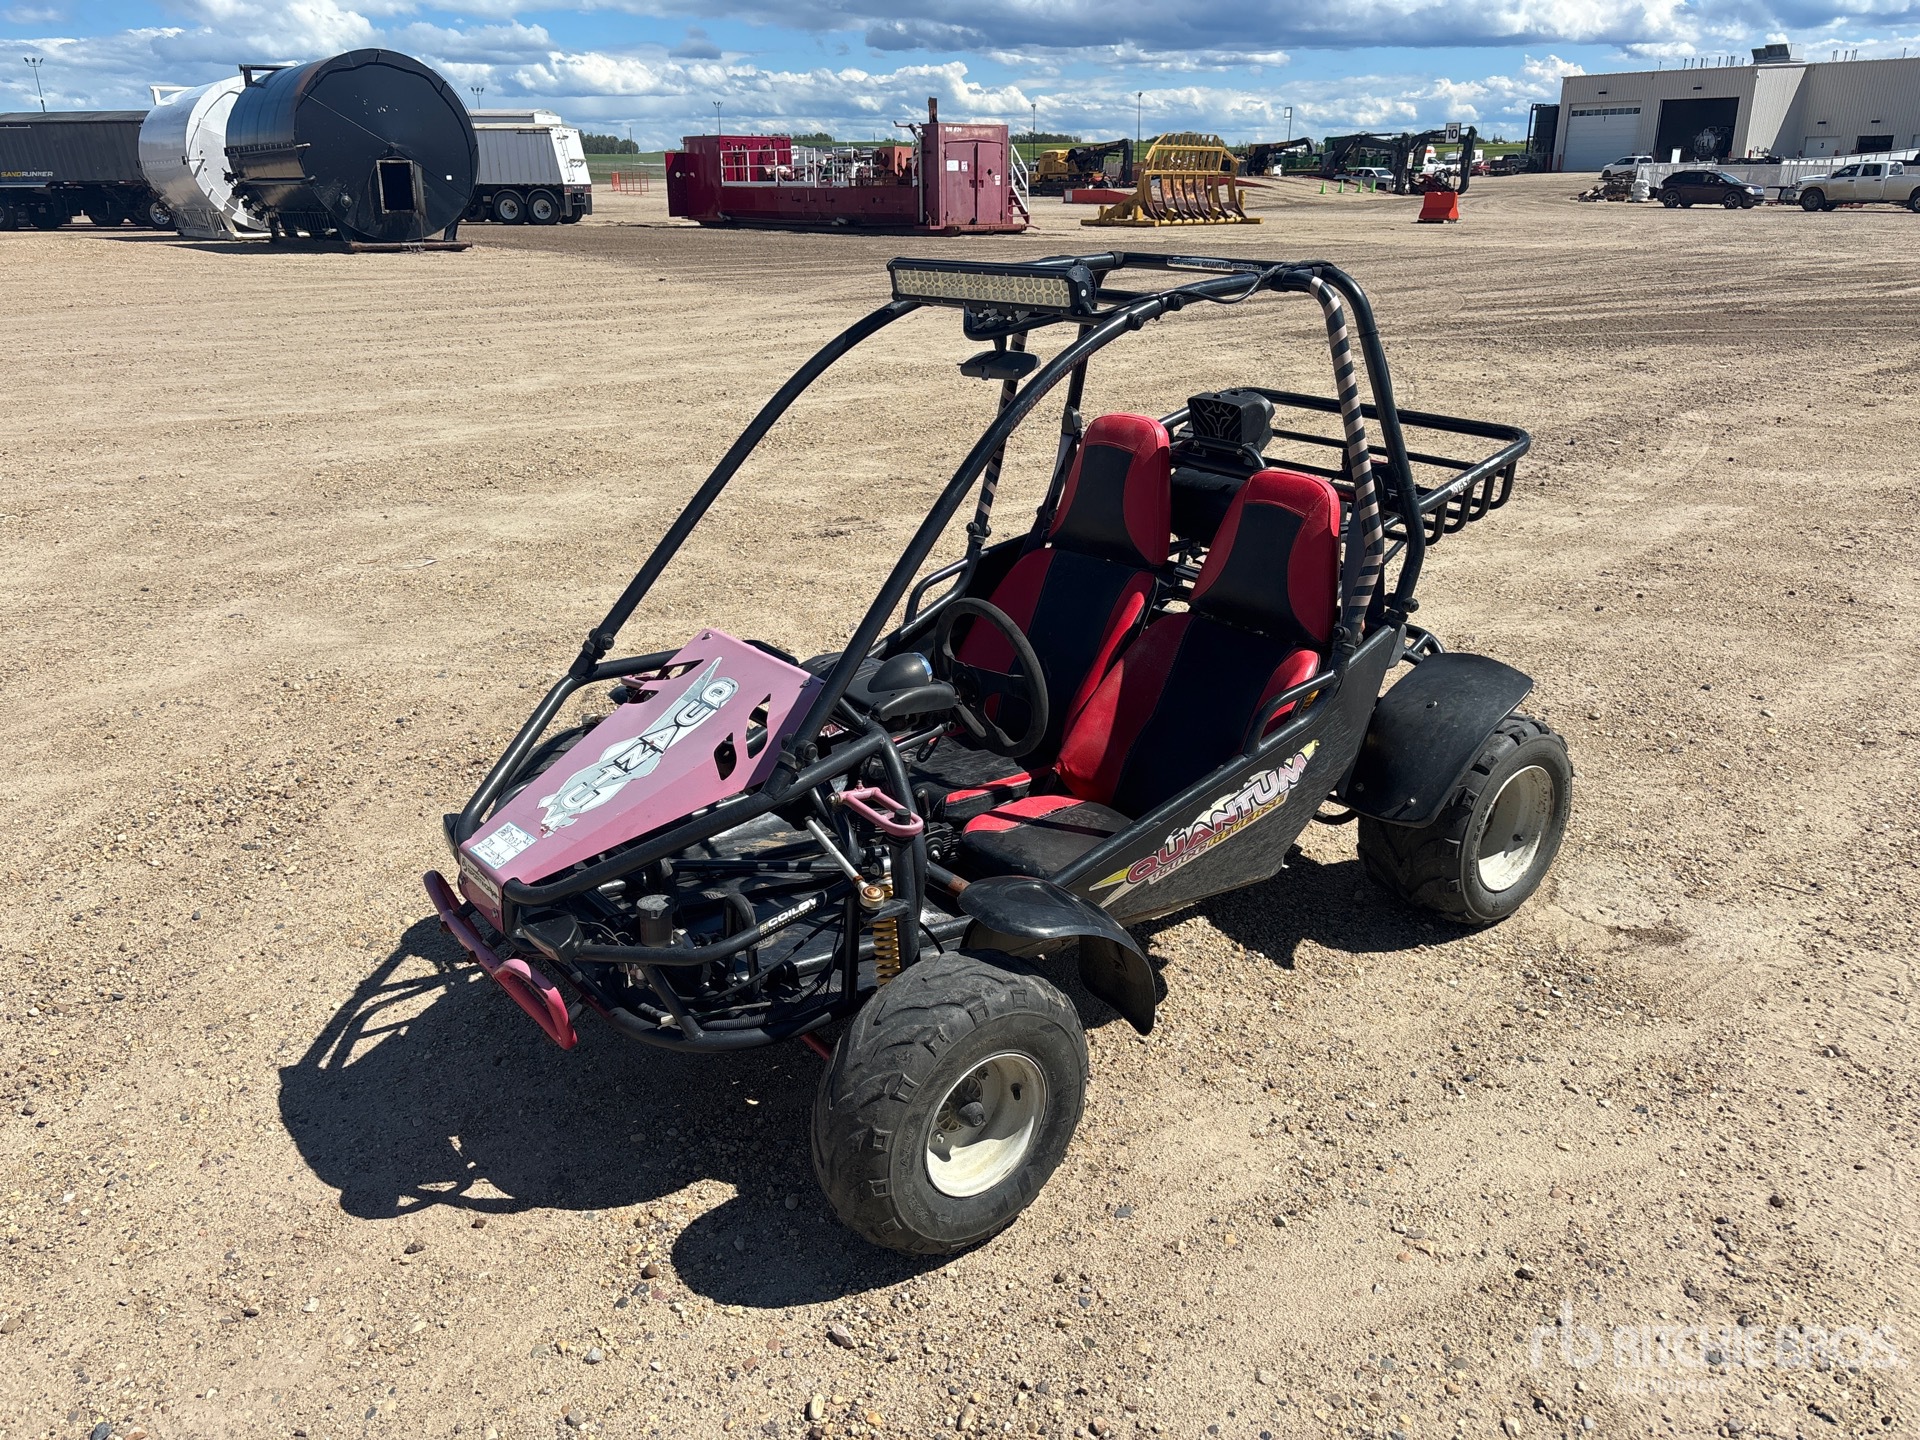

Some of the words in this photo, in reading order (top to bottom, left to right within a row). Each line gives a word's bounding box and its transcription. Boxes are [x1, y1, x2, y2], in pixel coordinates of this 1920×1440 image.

[1447, 129, 1458, 139] 10
[541, 679, 736, 839] QUANTUM
[1126, 752, 1308, 884] QUANTUM
